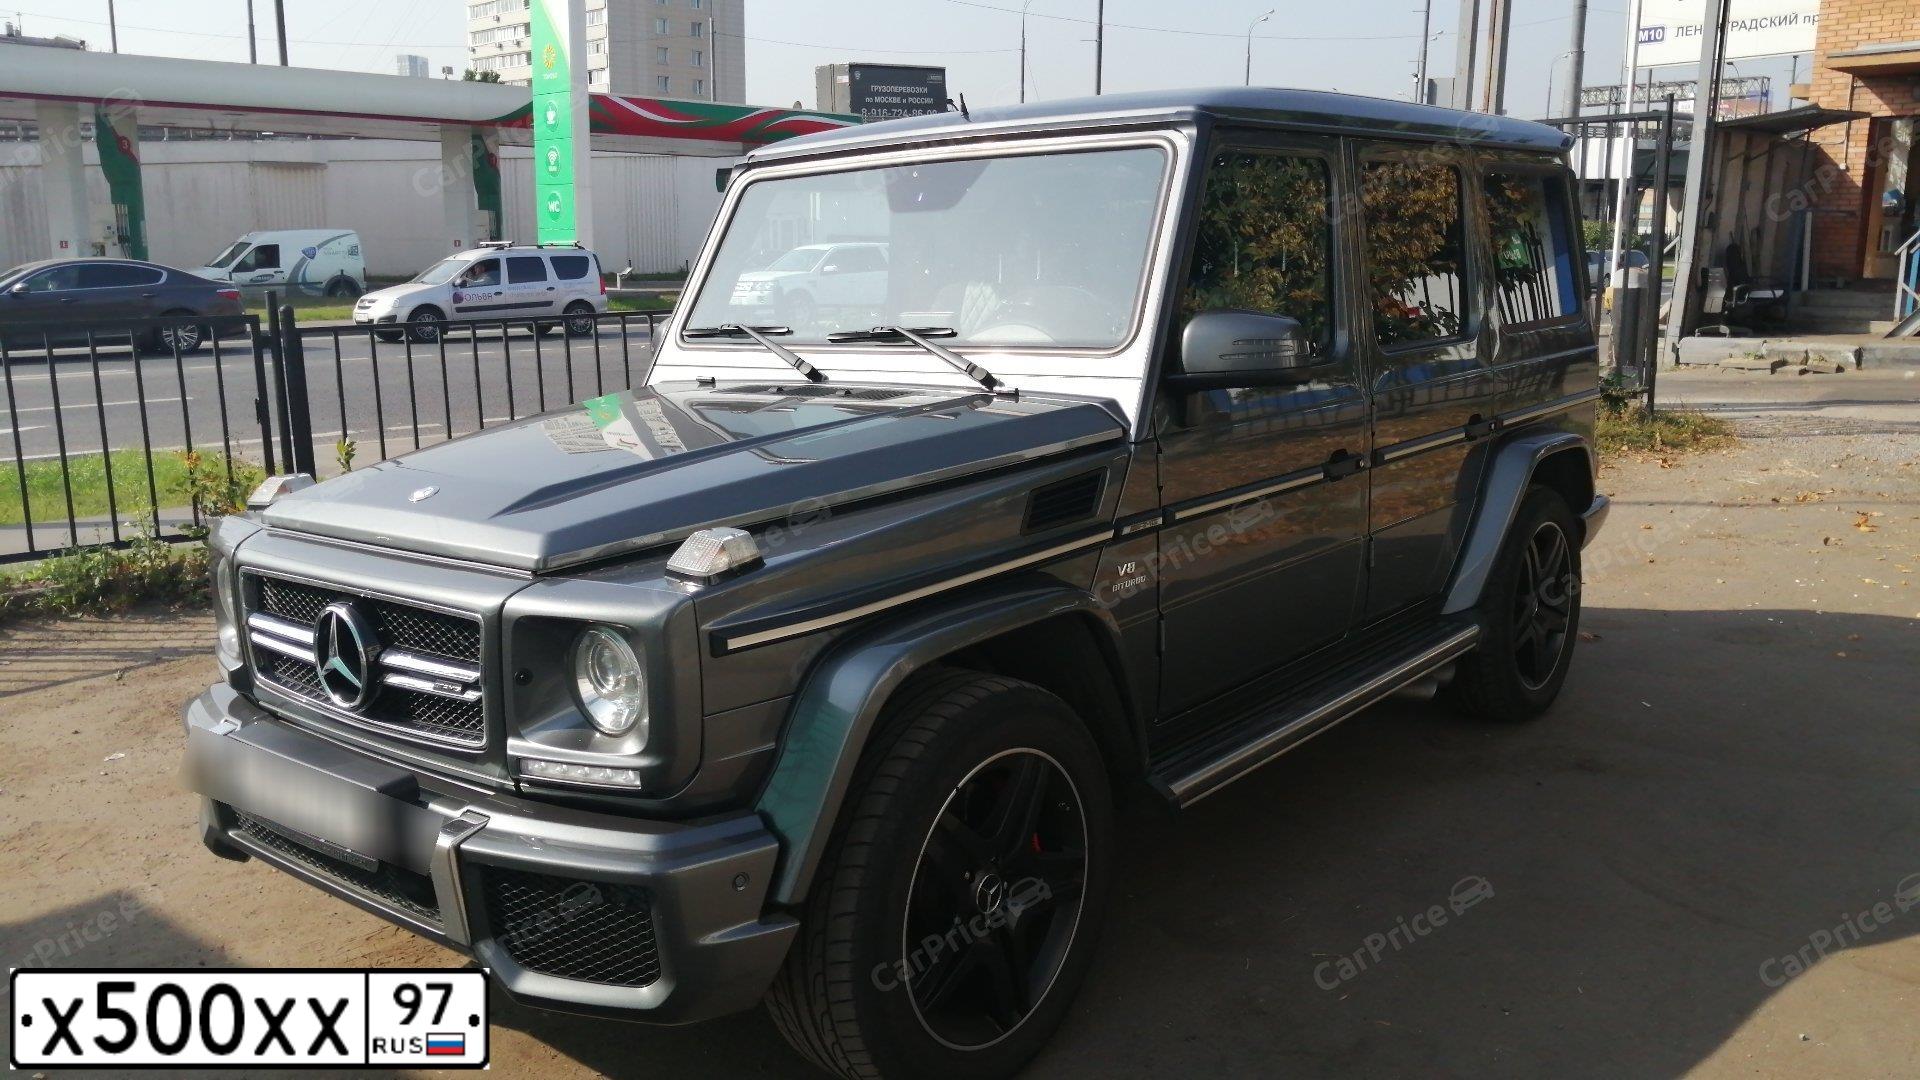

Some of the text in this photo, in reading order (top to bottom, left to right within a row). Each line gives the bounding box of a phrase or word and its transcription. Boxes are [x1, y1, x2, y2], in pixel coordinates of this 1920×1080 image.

[1675, 12, 1799, 38] ЛЕНРАДСКИЙ
[870, 85, 928, 94] ГРУЗОПЕРЕВОЗКИ
[874, 96, 901, 104] МОСКВЕ
[548, 200, 561, 213] WC
[1117, 561, 1136, 577] V8
